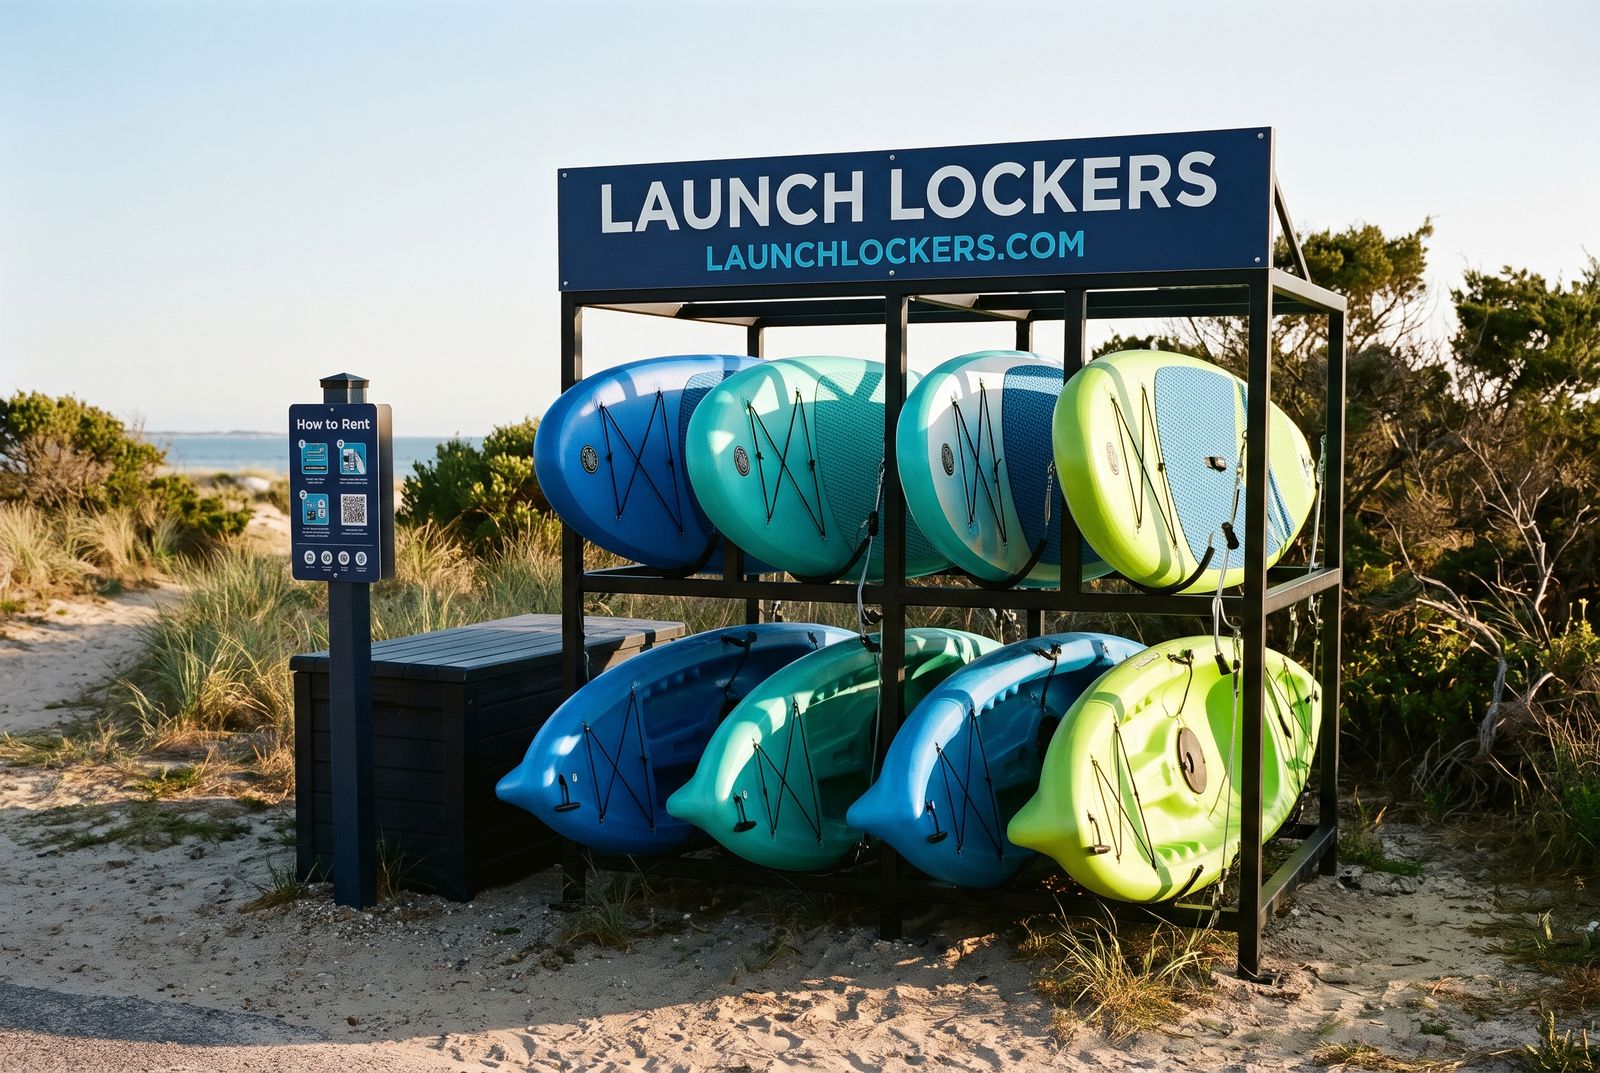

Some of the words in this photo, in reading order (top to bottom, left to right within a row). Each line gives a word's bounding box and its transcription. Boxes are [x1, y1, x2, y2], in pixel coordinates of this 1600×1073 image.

[601, 170, 865, 234] LAUNCH
[889, 150, 1218, 221] LOCKERS
[706, 230, 1086, 272] LAUNCHLOCKERS.COM
[296, 418, 323, 430] How
[325, 419, 339, 430] to
[342, 418, 370, 430] Rent
